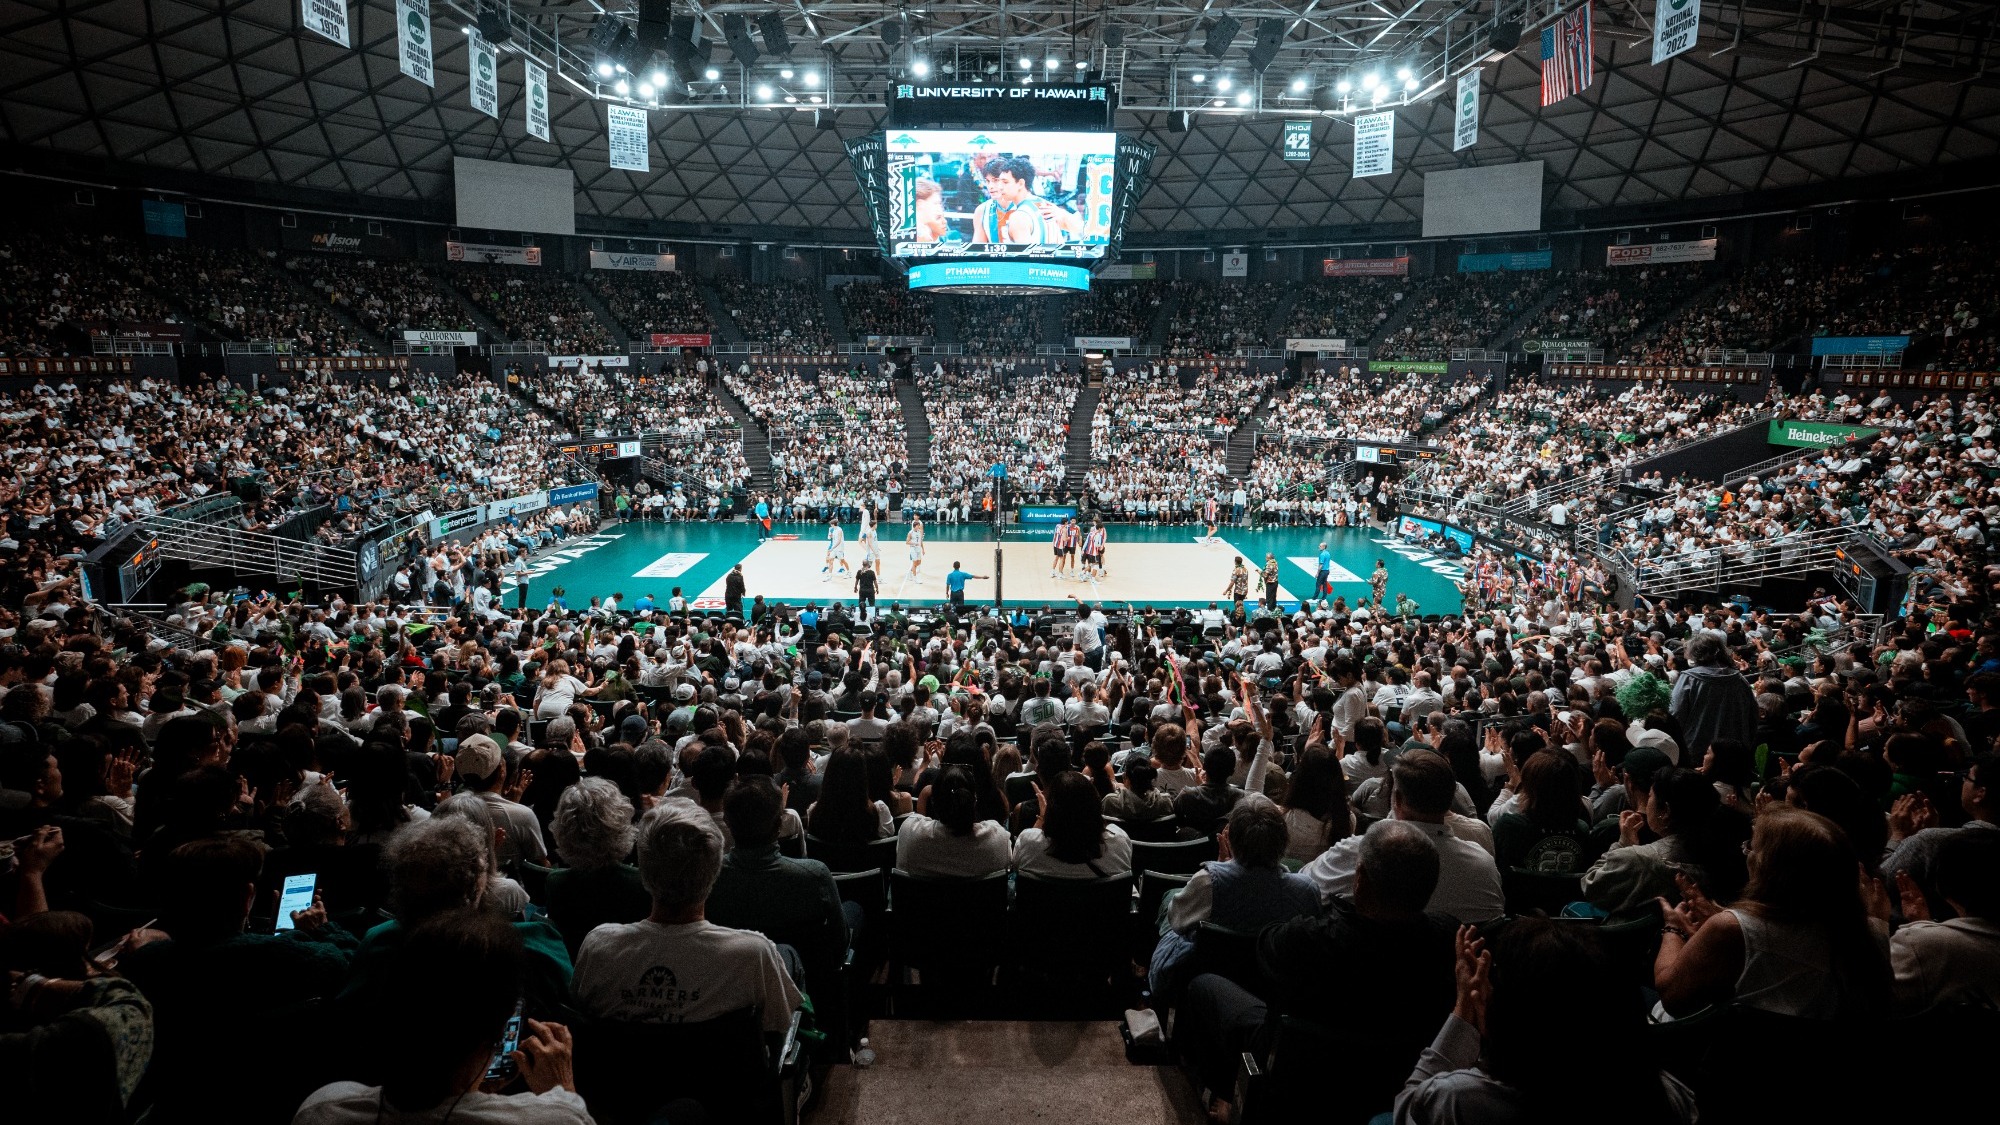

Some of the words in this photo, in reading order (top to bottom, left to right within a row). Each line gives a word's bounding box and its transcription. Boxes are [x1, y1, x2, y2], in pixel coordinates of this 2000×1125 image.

[312, 1, 345, 27] CHAMPION
[1666, 6, 1694, 28] NATIONAL
[320, 17, 340, 40] 1979
[1661, 16, 1696, 42] CHAMPIONS
[406, 40, 430, 60] NATIONAL
[1666, 33, 1688, 55] 2022
[406, 49, 431, 70] CHAMPION
[917, 88, 1005, 98] UNIVERSITY
[1010, 88, 1030, 98] OF
[851, 142, 883, 155] WAIKIKI
[1286, 132, 1310, 150] 42
[1120, 145, 1151, 160] WAIKIKI
[863, 154, 886, 239] MALIA
[1113, 158, 1140, 241] MALIA
[984, 244, 1007, 252] 1:30
[1611, 247, 1652, 258] PODS
[1655, 244, 1686, 252] 682-7637
[623, 256, 638, 266] AIR
[419, 331, 463, 341] CALIFORNIA
[1541, 340, 1566, 348] KUALOA
[441, 514, 478, 529] enterprise
[1032, 702, 1055, 722] 50
